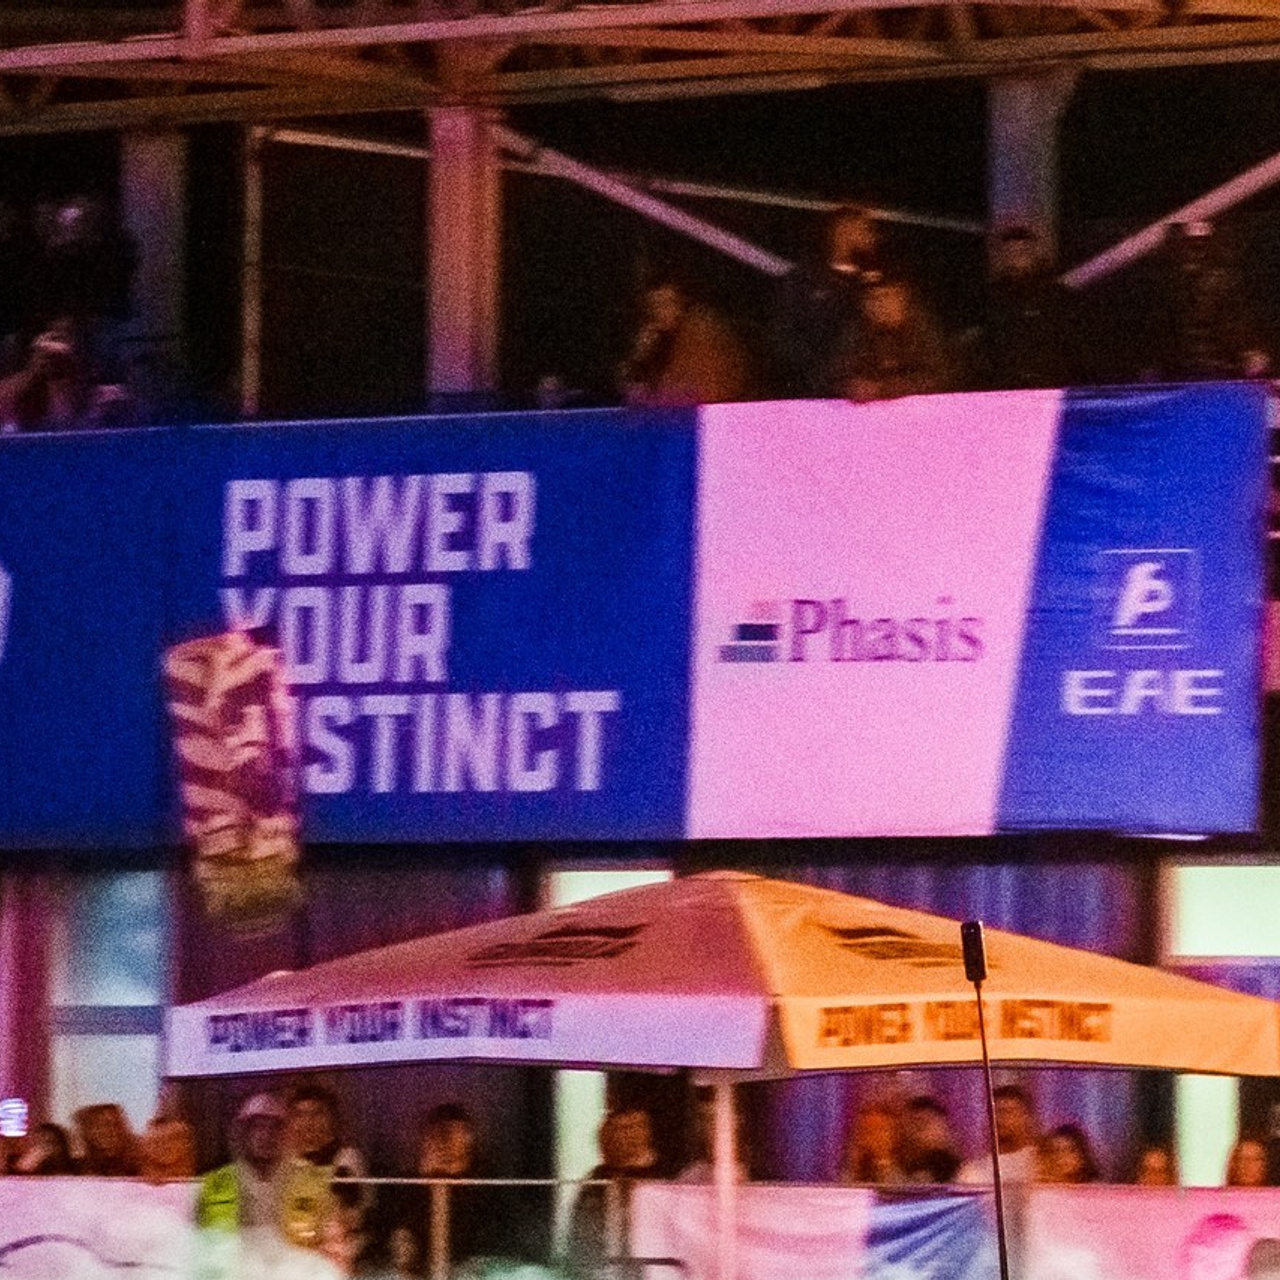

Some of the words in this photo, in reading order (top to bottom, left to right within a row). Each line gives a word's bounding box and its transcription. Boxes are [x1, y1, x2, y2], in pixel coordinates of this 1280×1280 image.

[223, 471, 536, 576] POWER
[786, 596, 986, 664] Phasis
[296, 690, 622, 794] STINCT
